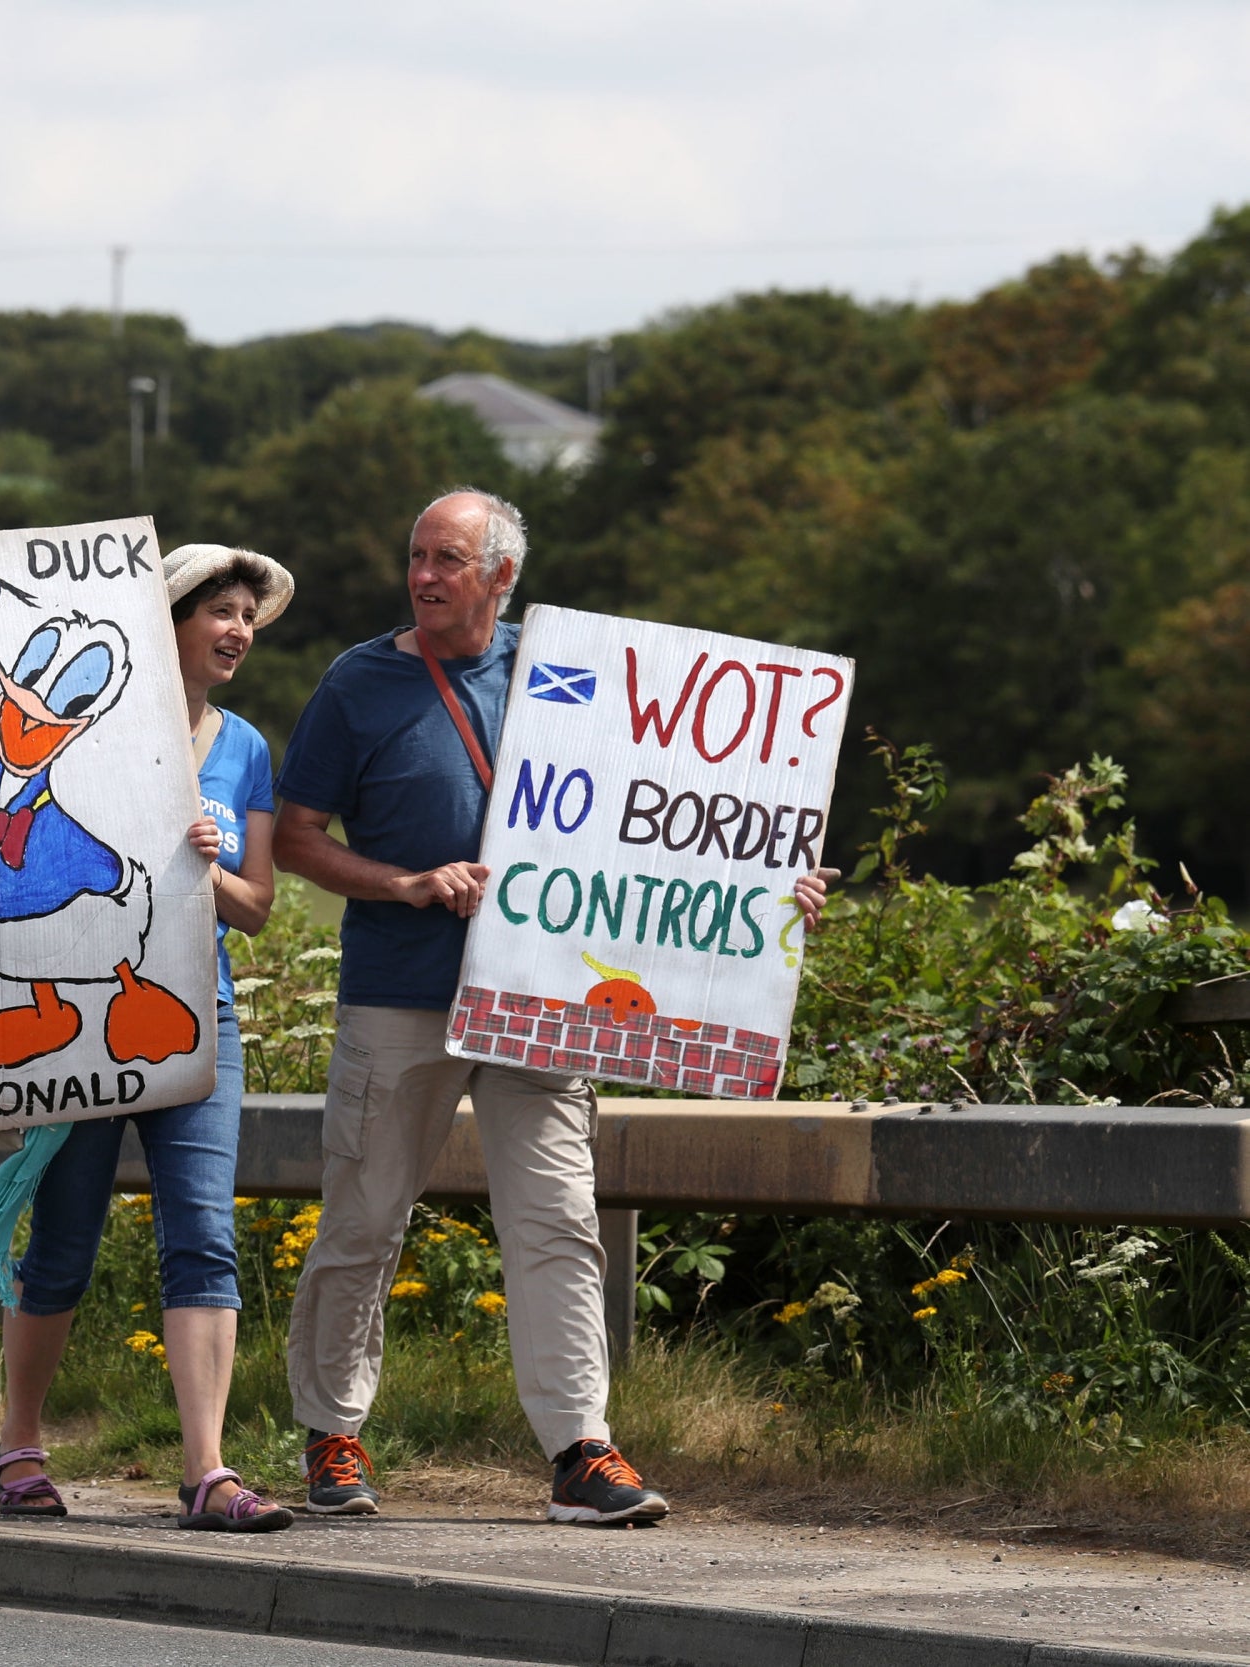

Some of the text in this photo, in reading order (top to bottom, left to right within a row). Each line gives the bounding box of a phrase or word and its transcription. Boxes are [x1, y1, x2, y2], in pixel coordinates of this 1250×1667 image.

[27, 533, 153, 581] DUCK
[626, 646, 844, 767] WOT?
[508, 759, 824, 870] NO BORDER
